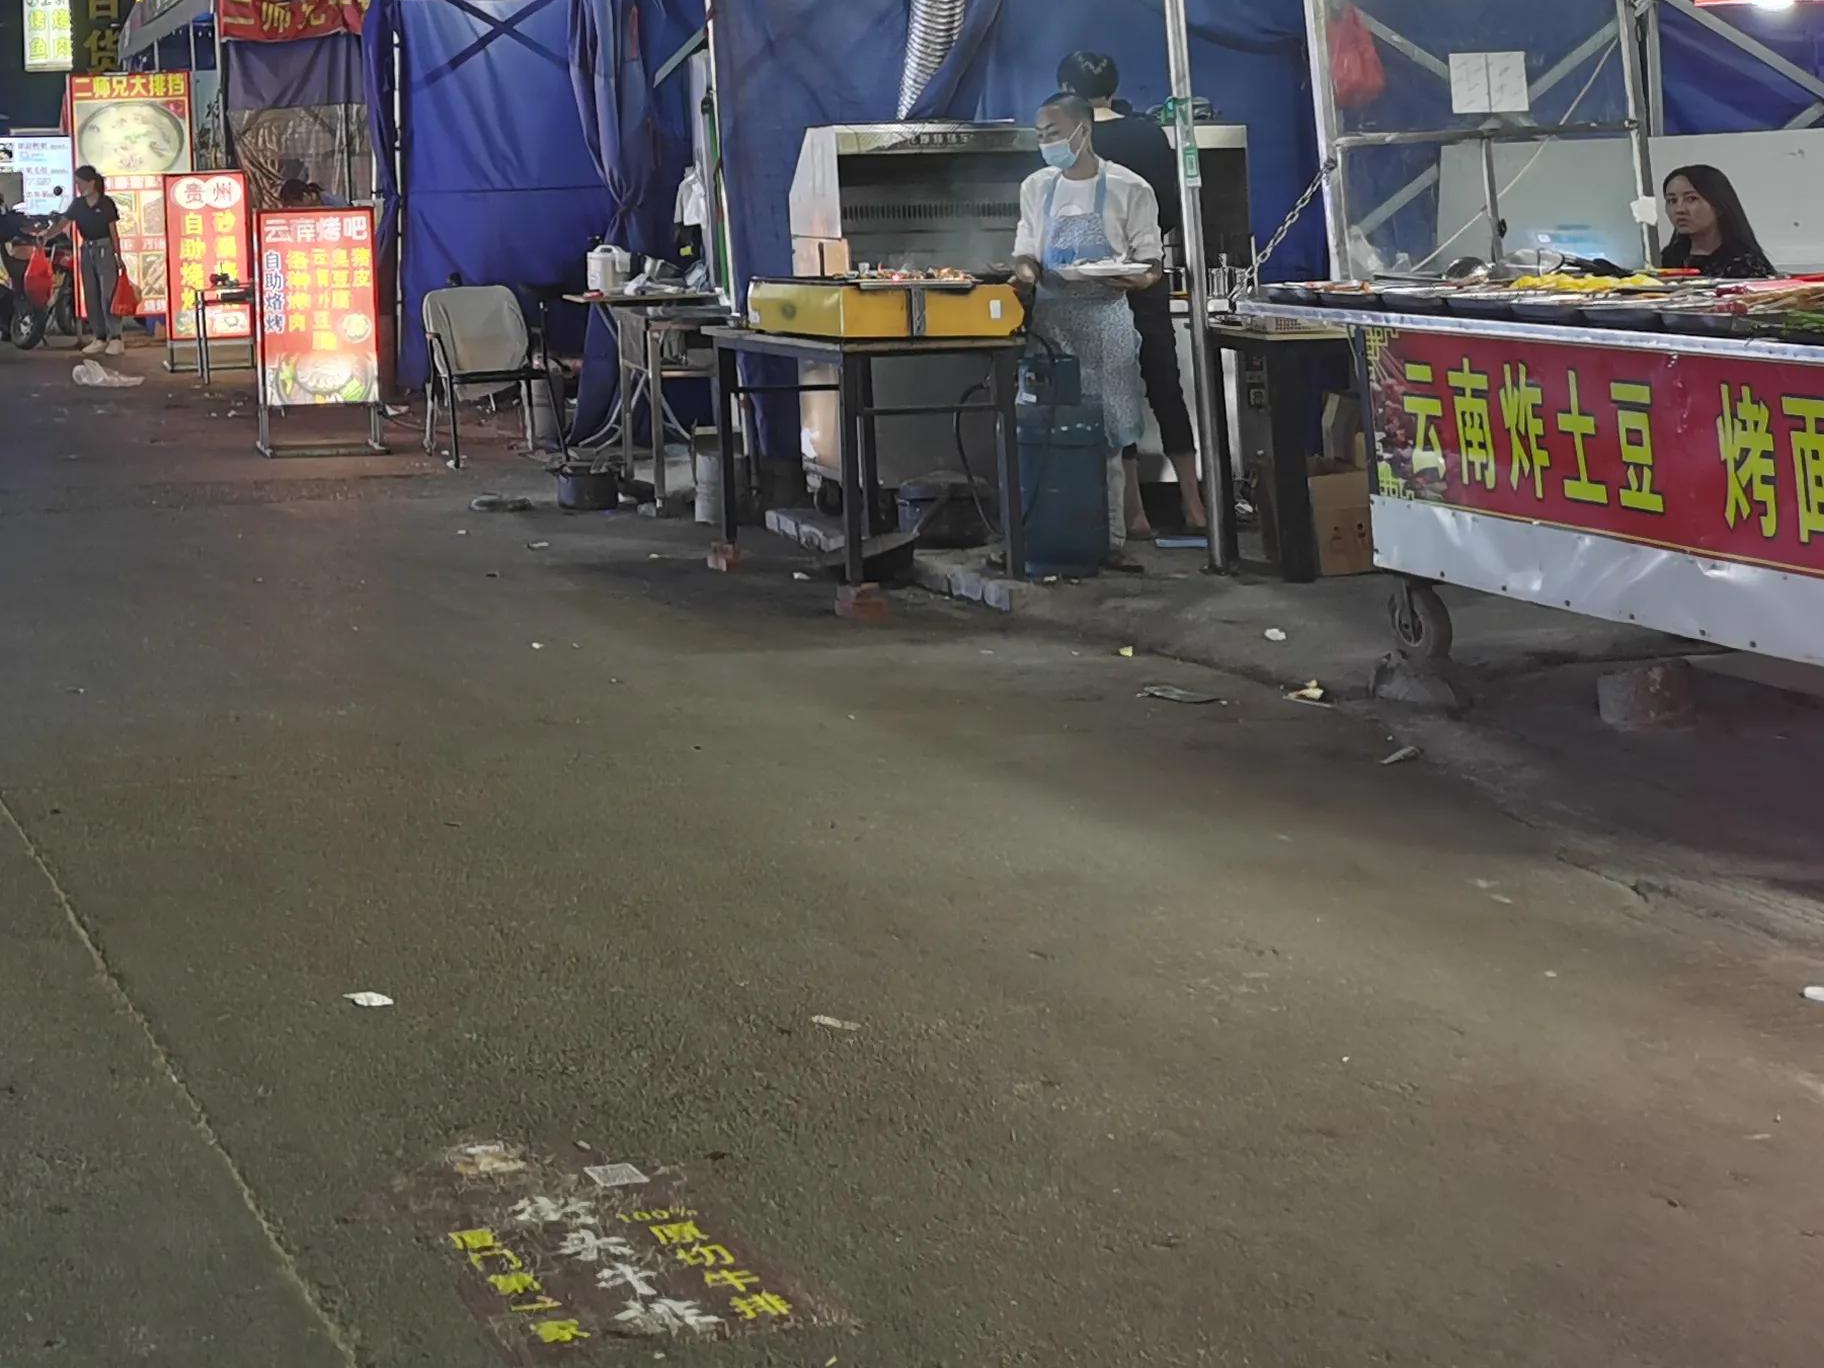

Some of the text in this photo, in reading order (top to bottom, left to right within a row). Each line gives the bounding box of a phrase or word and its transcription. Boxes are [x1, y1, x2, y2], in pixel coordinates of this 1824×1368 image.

[184, 181, 233, 204] 贵州
[1403, 357, 1665, 514] 云南炸土豆
